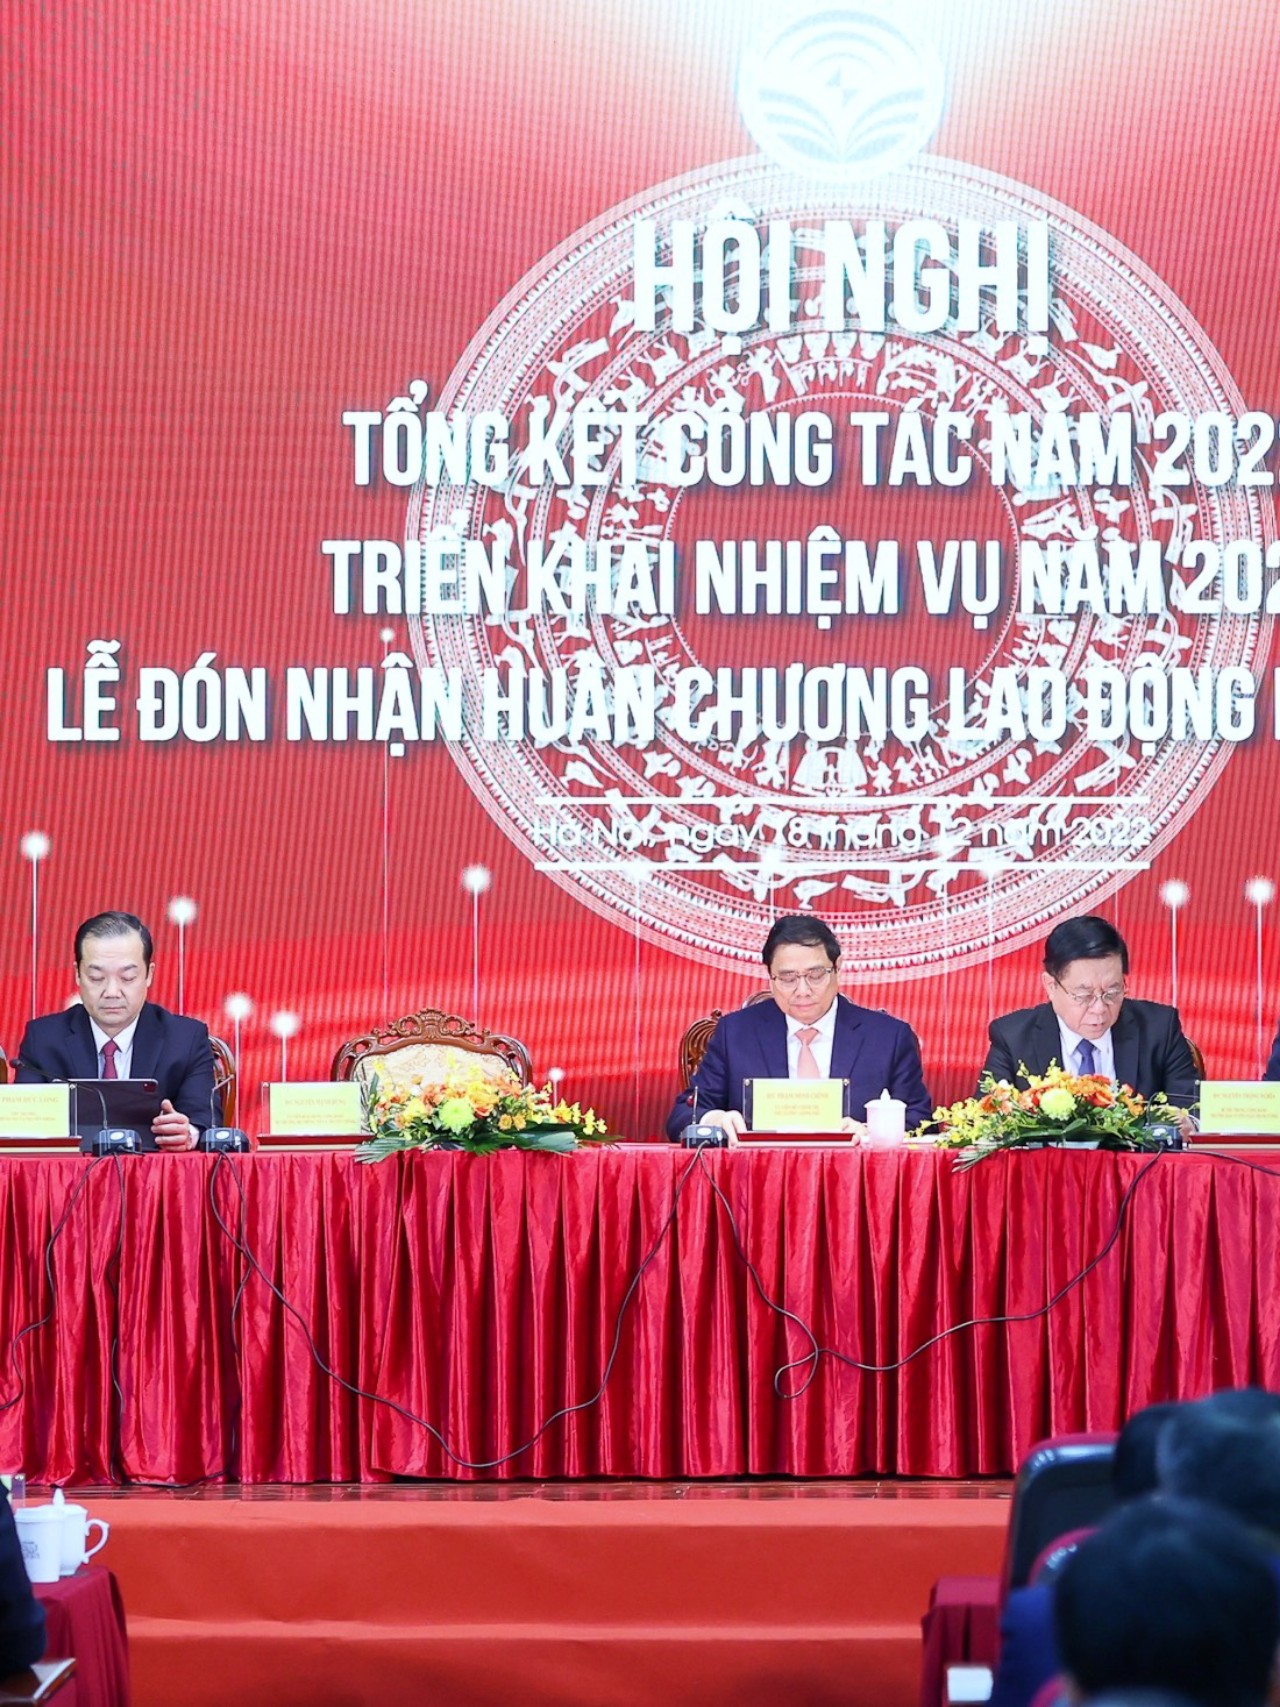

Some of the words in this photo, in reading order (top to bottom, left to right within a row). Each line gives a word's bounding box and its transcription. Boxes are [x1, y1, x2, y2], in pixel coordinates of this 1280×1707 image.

[634, 201, 789, 355] HỘI
[825, 218, 1050, 356] NGHỊ
[342, 379, 510, 486] TỔNG
[529, 383, 647, 486] KẾT
[664, 395, 832, 486] CÔNG
[851, 394, 971, 486] TÁC
[991, 395, 1132, 486] NĂM
[321, 507, 506, 615] TRIỂN
[527, 540, 674, 615] KHAI
[696, 525, 897, 629] NHIỆM
[916, 540, 999, 629] VỤ
[1020, 524, 1164, 615] NĂM
[46, 638, 120, 741] LỄ
[137, 652, 266, 741] ĐÓN
[287, 652, 462, 758] NHẬN
[484, 652, 653, 741] HUÂN
[674, 661, 929, 741] CHƯƠNG
[949, 665, 1066, 741] LAO
[1083, 653, 1255, 758] ĐỘNG
